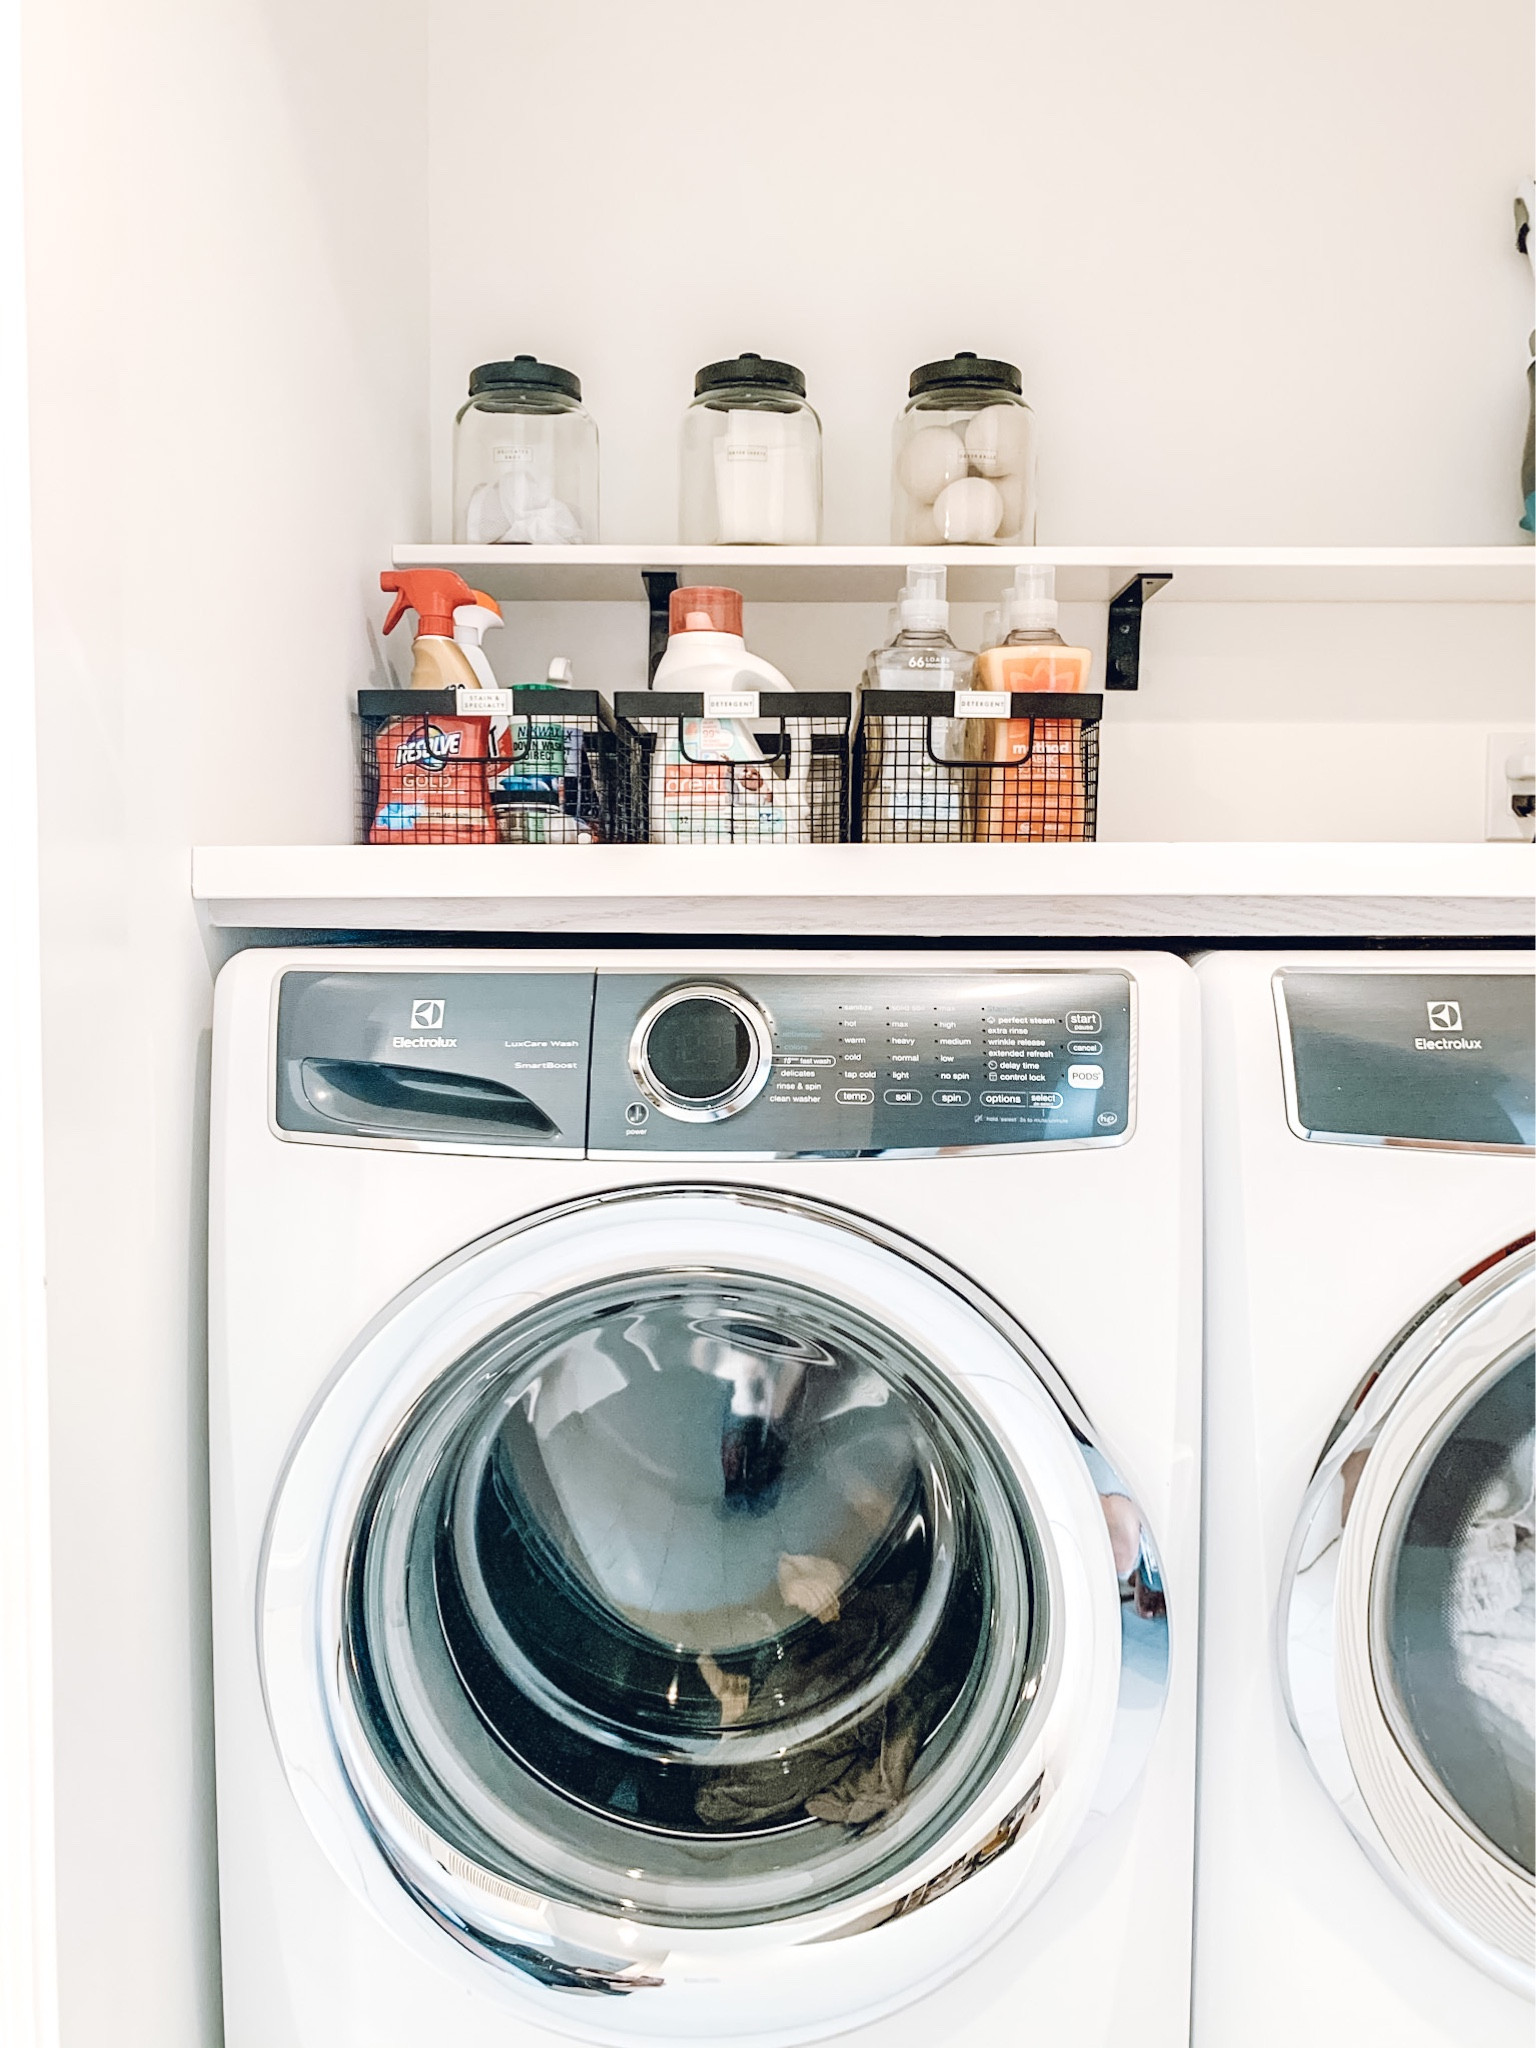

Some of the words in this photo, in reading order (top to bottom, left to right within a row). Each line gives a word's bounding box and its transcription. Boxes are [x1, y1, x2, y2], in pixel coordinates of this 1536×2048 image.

[908, 656, 925, 668] 66
[518, 726, 561, 738] NKWAX
[1012, 741, 1070, 755] mthod
[402, 773, 452, 788] GOLD
[998, 1016, 1028, 1025] perfect
[1029, 1017, 1056, 1025] steam
[1070, 1014, 1097, 1024] start
[844, 1020, 857, 1028] hot
[940, 1021, 957, 1030] high
[1008, 1027, 1029, 1035] rinse
[392, 1036, 457, 1049] Electrolux
[504, 1040, 548, 1048] LuxCare
[891, 1037, 916, 1046] heavy
[940, 1037, 972, 1045] medium
[987, 1038, 1016, 1046] wrinkle
[1017, 1039, 1046, 1047] release
[1414, 1037, 1483, 1050] Electrolux
[1072, 1044, 1097, 1052] cancel
[844, 1053, 862, 1061] cold
[892, 1054, 920, 1062] normal
[988, 1049, 1025, 1058] extended
[1026, 1049, 1054, 1058] refresh
[940, 1054, 955, 1063] low
[514, 1061, 578, 1069] SmartBoost
[999, 1061, 1021, 1071] delay
[1022, 1061, 1040, 1070] time
[780, 1069, 816, 1078] delicates
[844, 1070, 858, 1080] tap
[859, 1070, 877, 1079] cold
[892, 1071, 910, 1081] light
[952, 1072, 970, 1081] spin
[999, 1073, 1028, 1081] control
[1028, 1073, 1046, 1082] lock
[776, 1082, 796, 1090] rinse
[797, 1082, 804, 1090] &
[805, 1082, 822, 1092] spin
[769, 1094, 791, 1103] clean
[792, 1095, 821, 1103] washer
[843, 1091, 868, 1102] temp
[895, 1092, 912, 1102] soil
[941, 1093, 962, 1104] spin
[985, 1094, 1022, 1104] options
[1030, 1093, 1056, 1103] select
[625, 1128, 648, 1137] power
